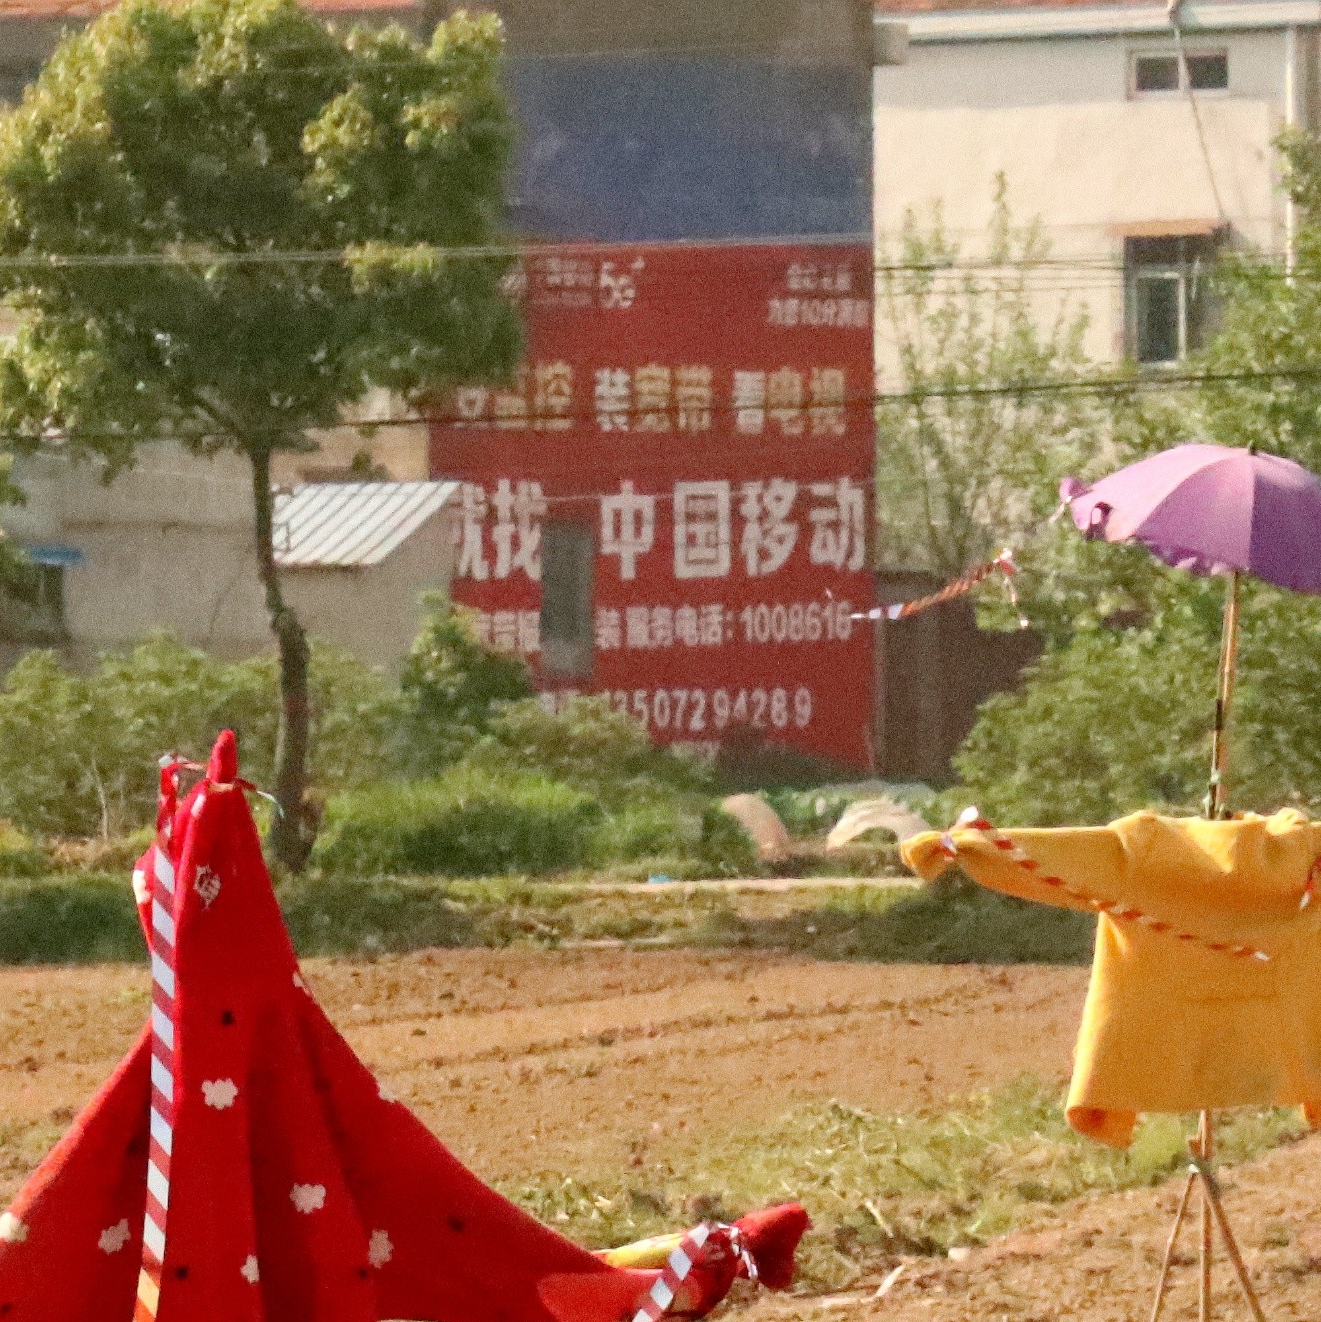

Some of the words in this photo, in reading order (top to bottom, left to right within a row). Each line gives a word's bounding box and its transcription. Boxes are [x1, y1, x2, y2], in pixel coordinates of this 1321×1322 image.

[595, 364, 713, 434] 装宽带
[732, 366, 847, 436] 看电视
[601, 477, 867, 581] 中国移动
